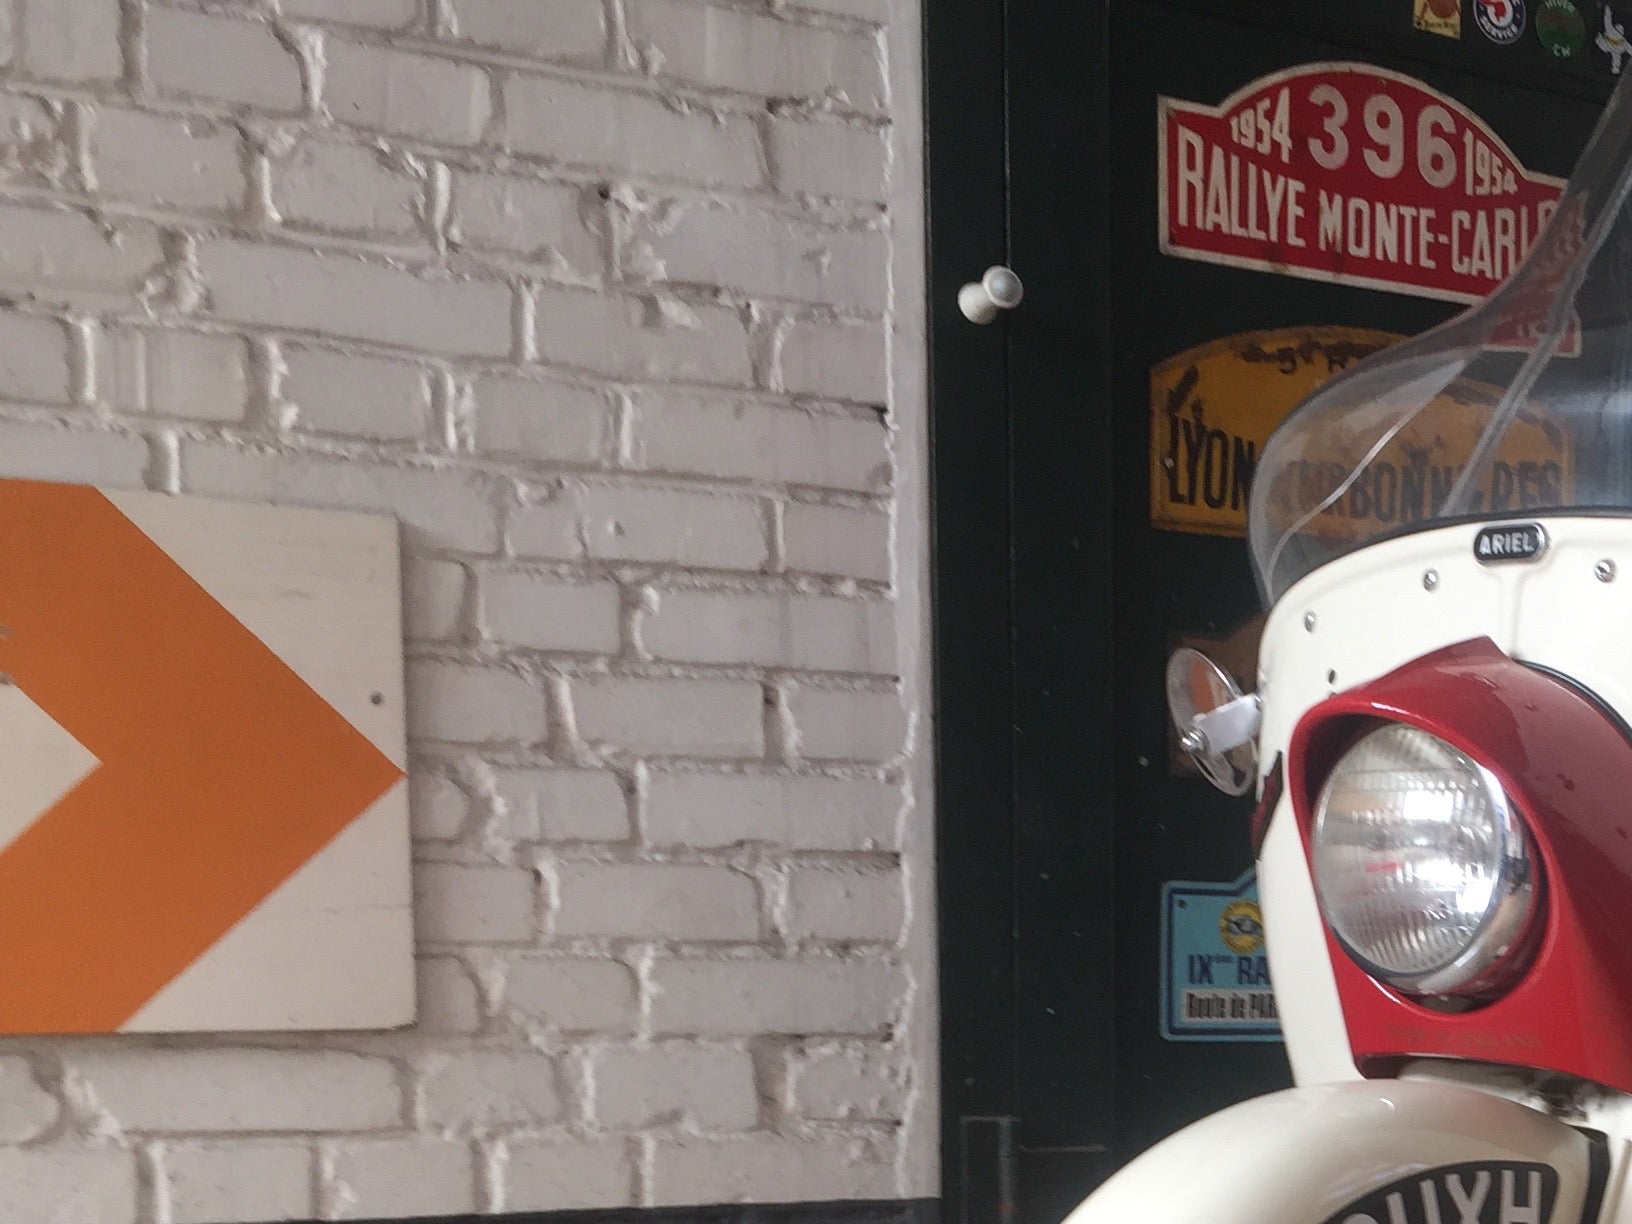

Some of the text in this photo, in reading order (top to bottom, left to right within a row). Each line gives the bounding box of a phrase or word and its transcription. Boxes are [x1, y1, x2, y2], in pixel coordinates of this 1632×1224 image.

[1178, 123, 1306, 249] RALLYE
[1230, 83, 1519, 197] 1954 396 1954
[1479, 531, 1535, 556] ARIEL
